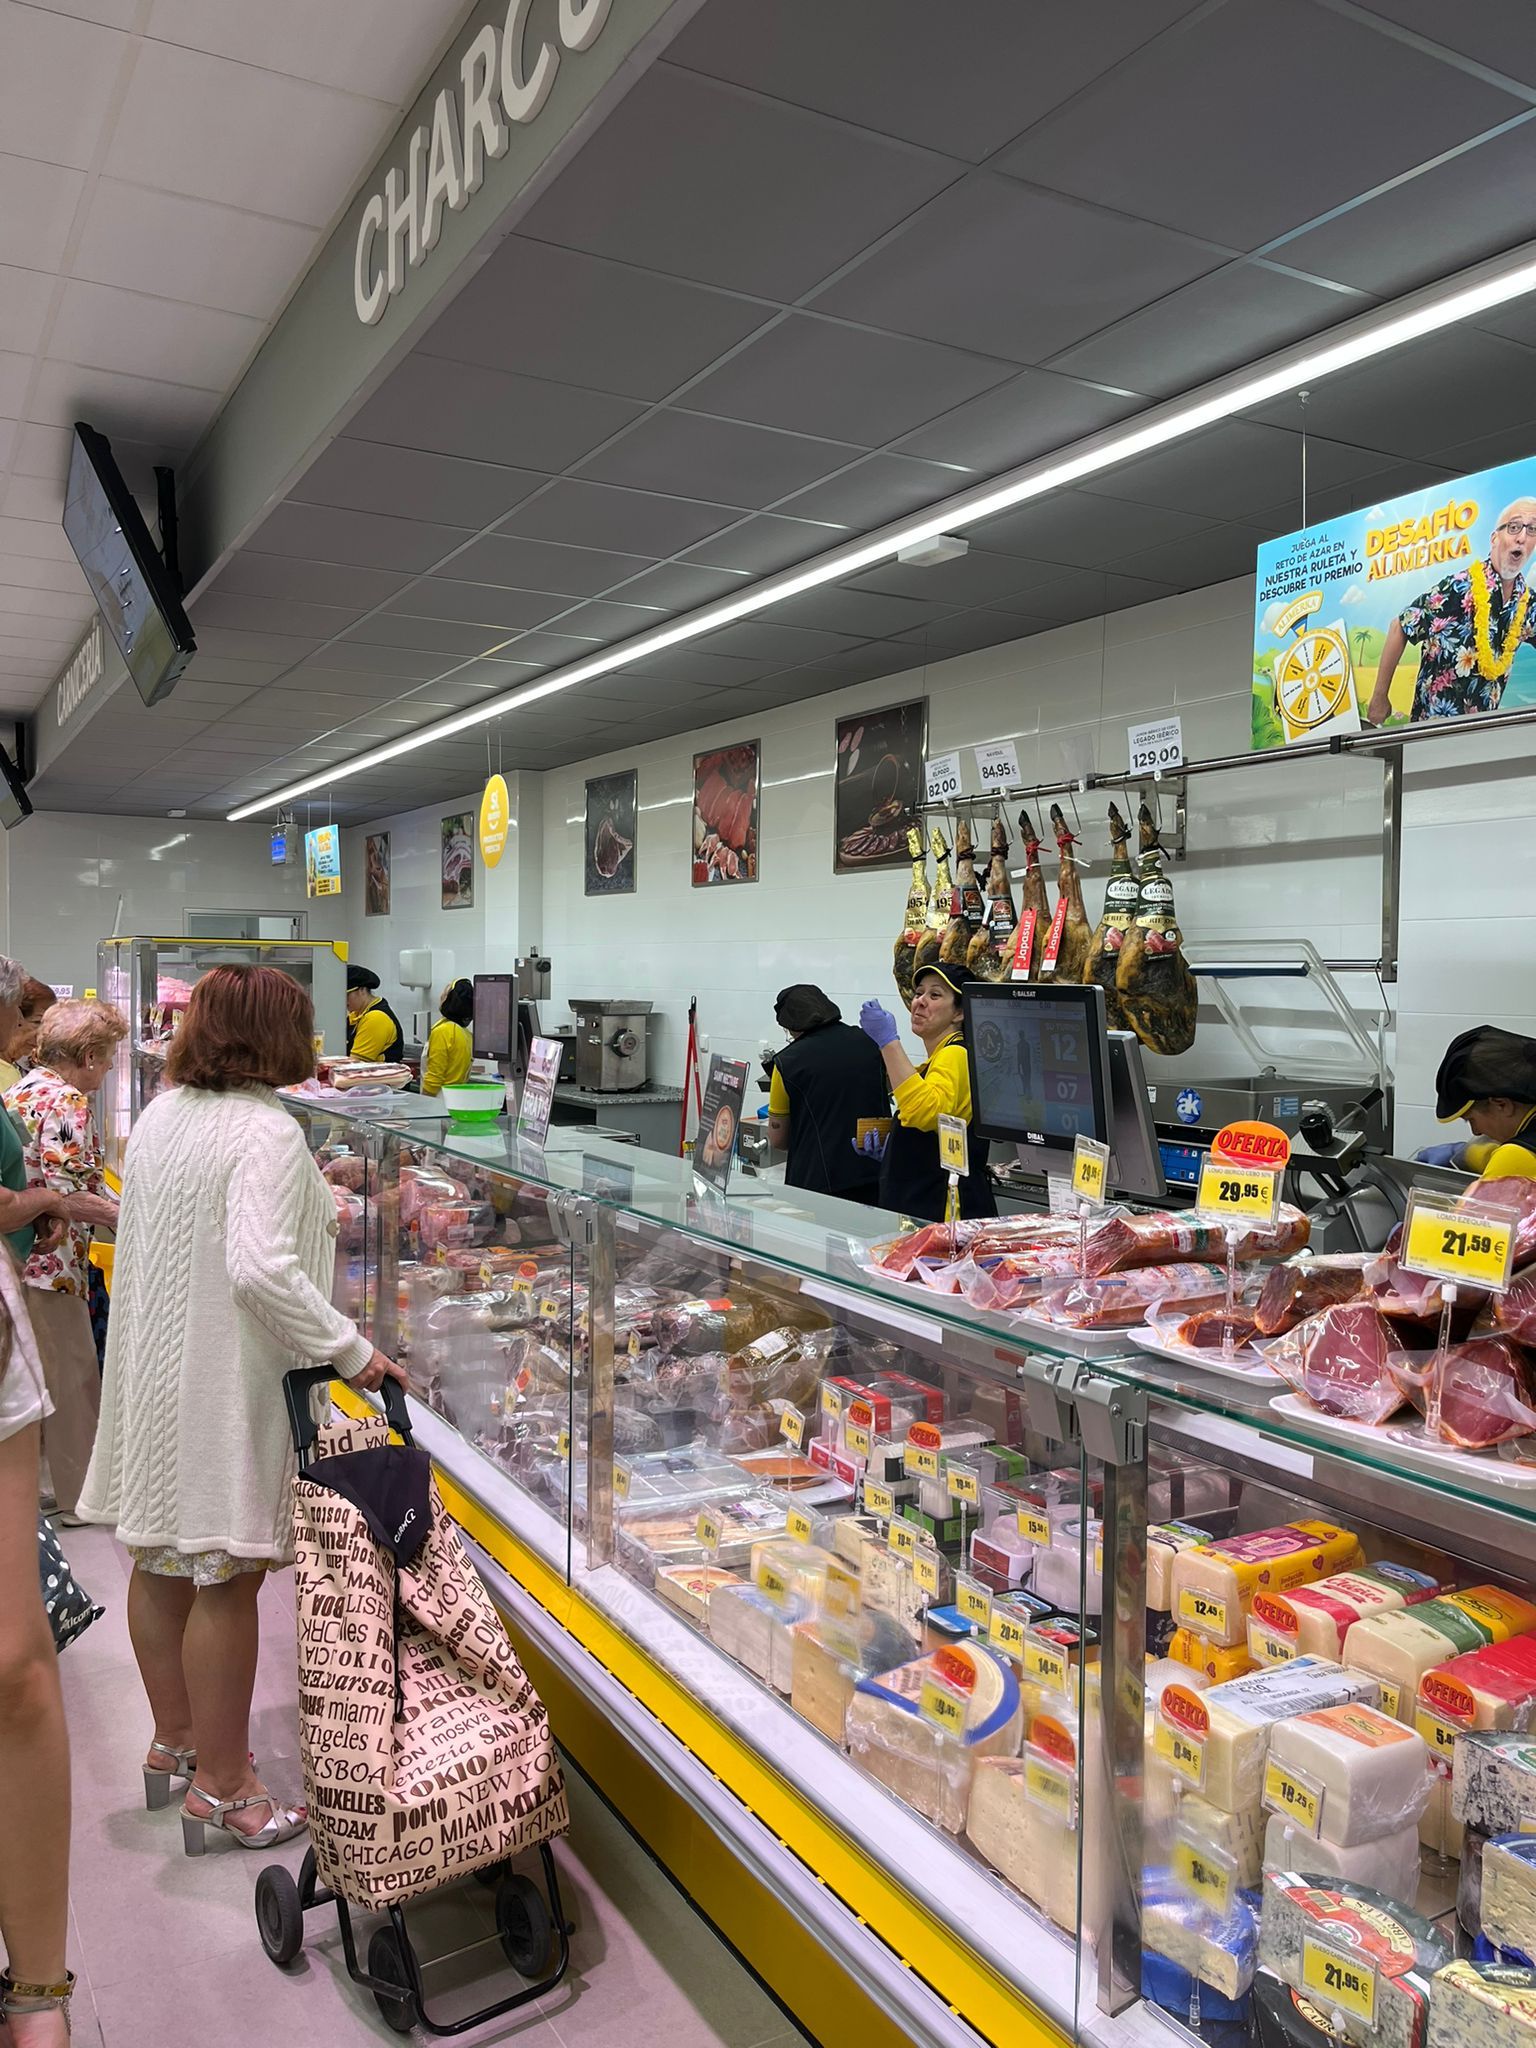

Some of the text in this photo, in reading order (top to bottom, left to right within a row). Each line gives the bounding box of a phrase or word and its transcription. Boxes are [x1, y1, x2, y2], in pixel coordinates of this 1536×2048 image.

[354, 0, 612, 326] CHARC
[1275, 541, 1345, 571] RETO DE AZAR EN
[1291, 533, 1329, 554] JUEGA AL
[1367, 534, 1472, 583] ALIMERKA
[1259, 561, 1364, 603] DESCUBRE TU PREMIO
[1264, 548, 1358, 588] NUESTRA RULETA Y
[1133, 734, 1156, 745] LEGADO
[982, 762, 1017, 779] 84,95 €
[1132, 745, 1180, 768] 129,00
[928, 777, 957, 798] 82,00
[1017, 919, 1032, 961] Japasur
[1050, 908, 1063, 951] Japasur
[1050, 1033, 1078, 1062] 12
[1056, 1081, 1078, 1100] 07
[1176, 1094, 1201, 1115] ak
[1061, 1113, 1079, 1132] 01
[1217, 1129, 1288, 1160] OFERTA
[1219, 1181, 1269, 1203] 29,95 €
[1436, 1213, 1457, 1223] LOMO
[1441, 1229, 1505, 1257] 21,59 €
[1326, 1576, 1384, 1605] Clásico
[1194, 1599, 1218, 1617] 12,45
[1253, 1594, 1299, 1632] OFERTA
[411, 1654, 446, 1675] san
[1162, 1688, 1209, 1732] OFERTA
[1422, 1675, 1474, 1715] OFERTA
[327, 1696, 387, 1726] miami
[430, 1711, 491, 1748] moskva
[478, 1718, 519, 1745] SAN
[389, 1754, 489, 1805] TOKIO
[454, 1768, 513, 1812] NEW
[1280, 1780, 1308, 1808] 18,25
[440, 1802, 498, 1847] MIAMI
[343, 1836, 435, 1867] CHICAGO
[441, 1834, 495, 1870] PISA
[353, 1861, 437, 1895] Firenze
[1324, 1962, 1369, 1997] 21,95 €
